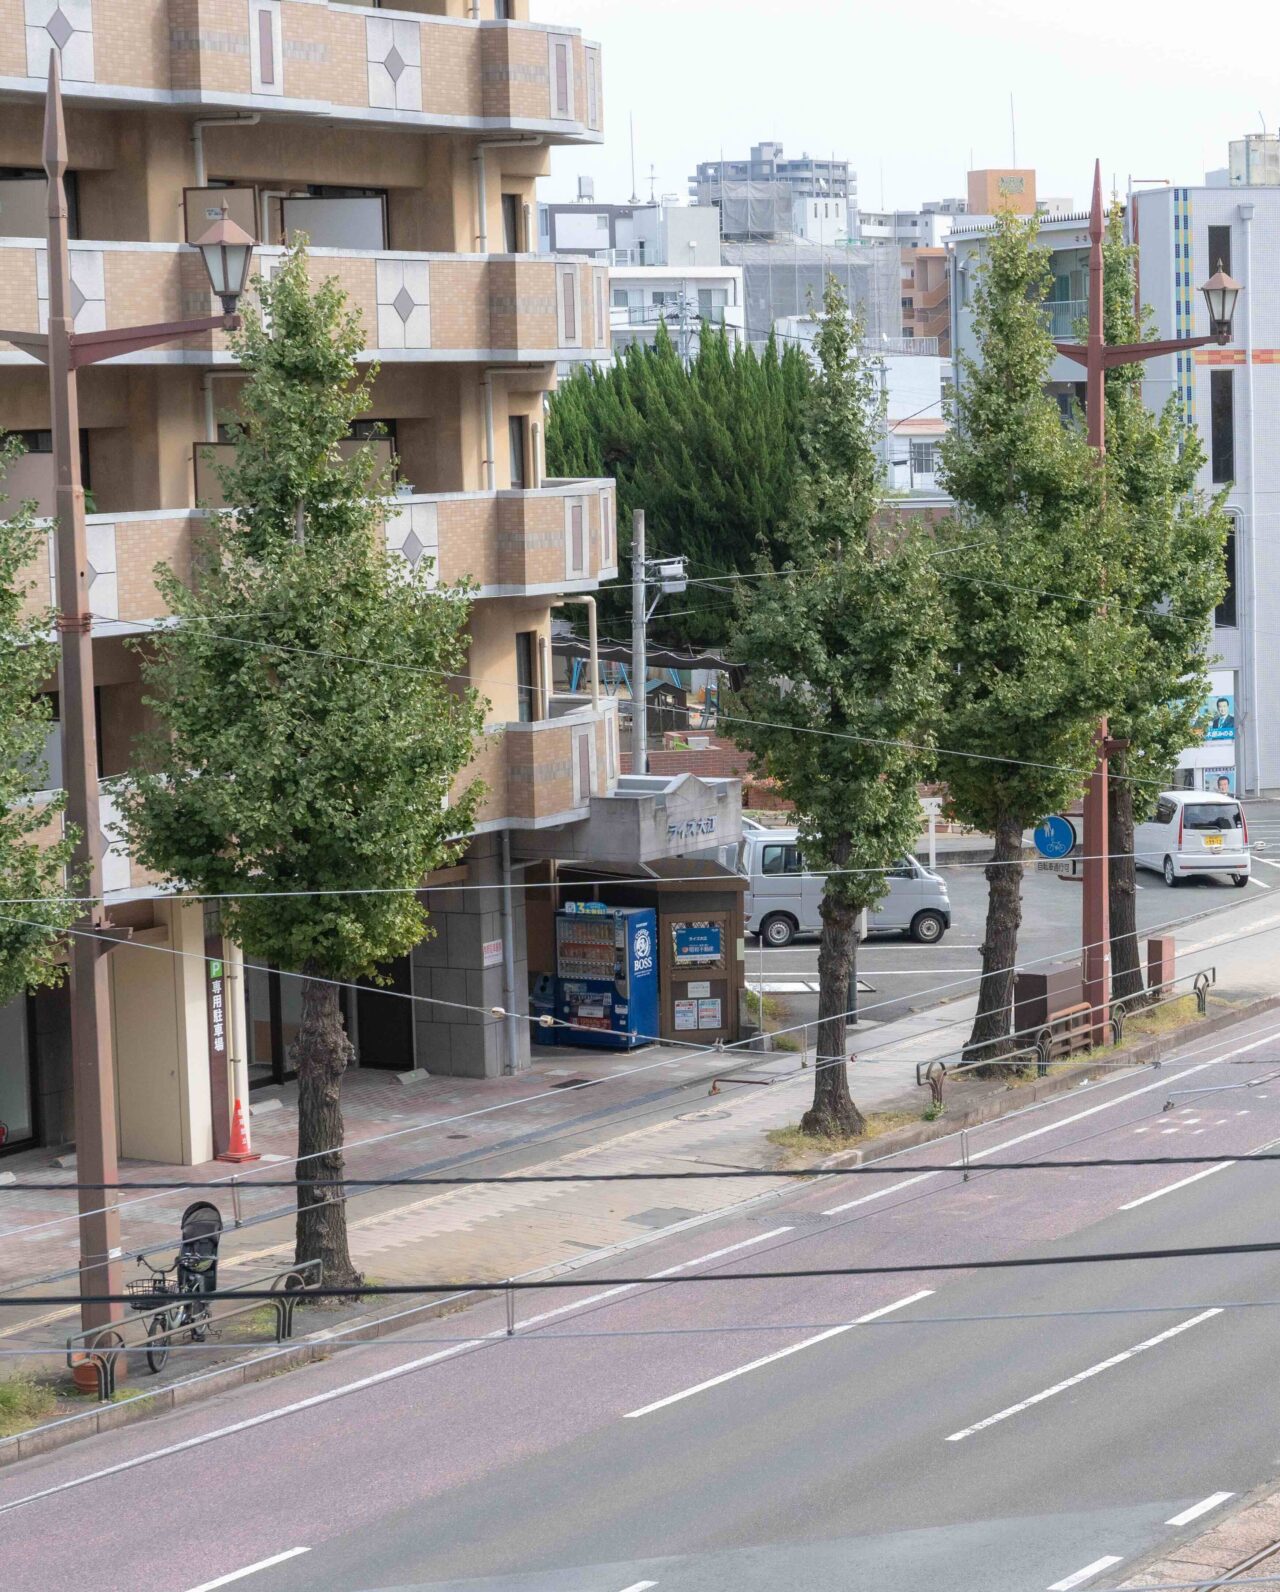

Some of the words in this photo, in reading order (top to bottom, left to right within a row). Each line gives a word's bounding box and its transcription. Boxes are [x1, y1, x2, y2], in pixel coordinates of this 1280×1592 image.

[213, 962, 221, 977] P
[633, 957, 653, 971] BOSS
[211, 980, 225, 1052] 専用駐車場
